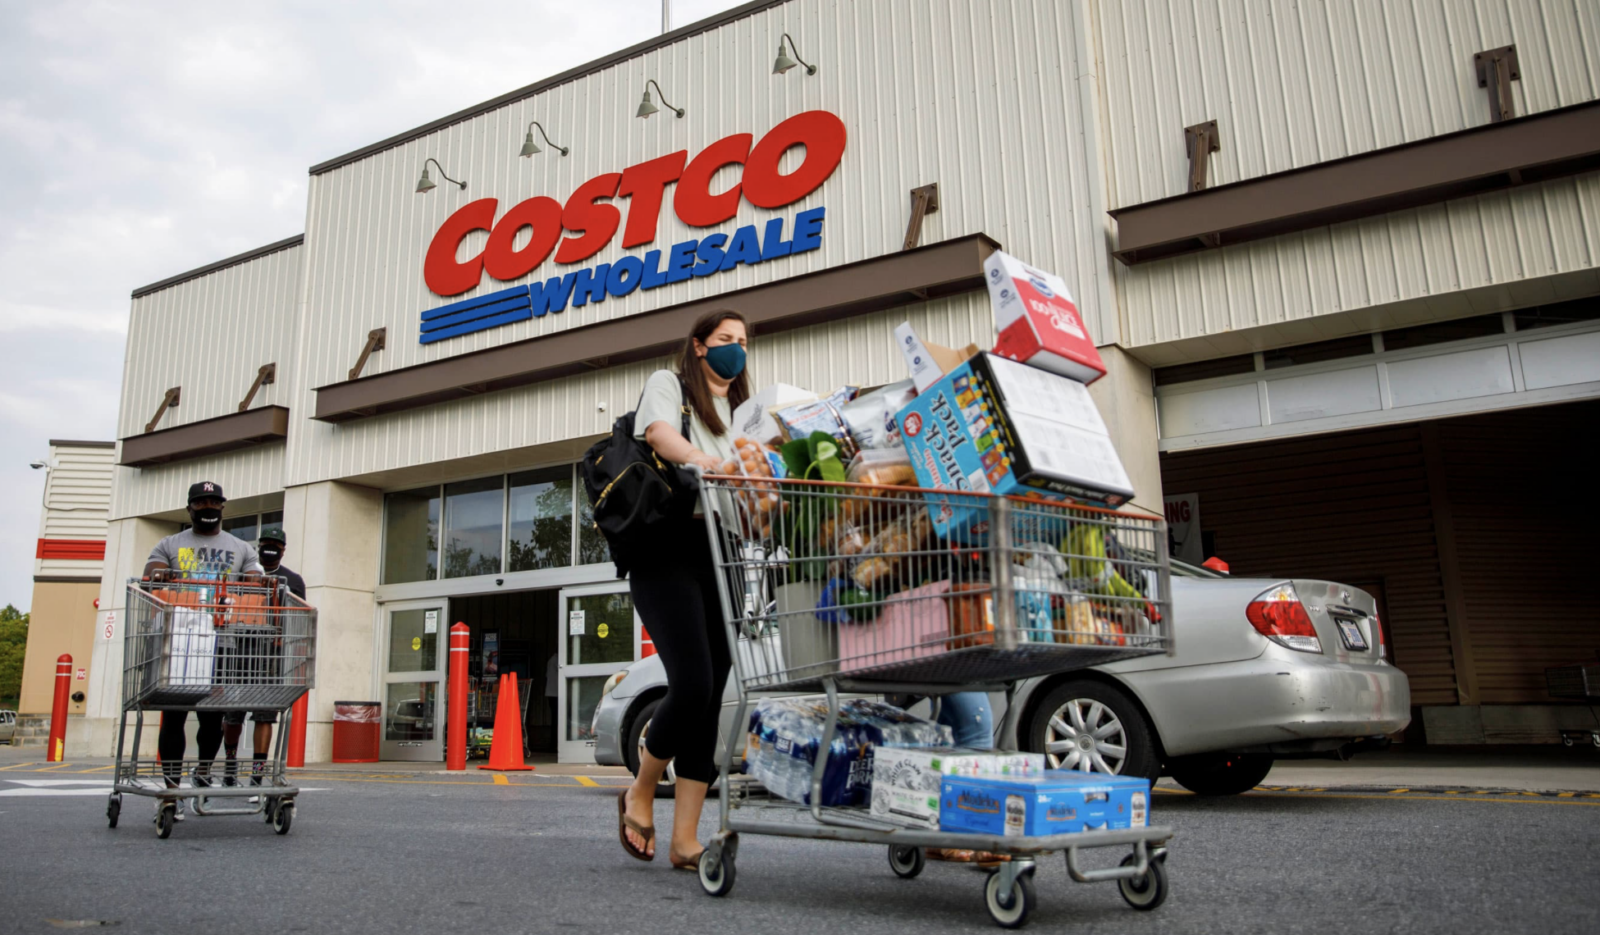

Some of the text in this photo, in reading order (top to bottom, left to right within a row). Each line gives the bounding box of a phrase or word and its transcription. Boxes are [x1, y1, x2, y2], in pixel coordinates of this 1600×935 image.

[423, 110, 847, 297] COSTCO
[529, 206, 826, 317] WHOLESALE
[178, 547, 235, 566] MAKE
[845, 770, 874, 789] PARK
